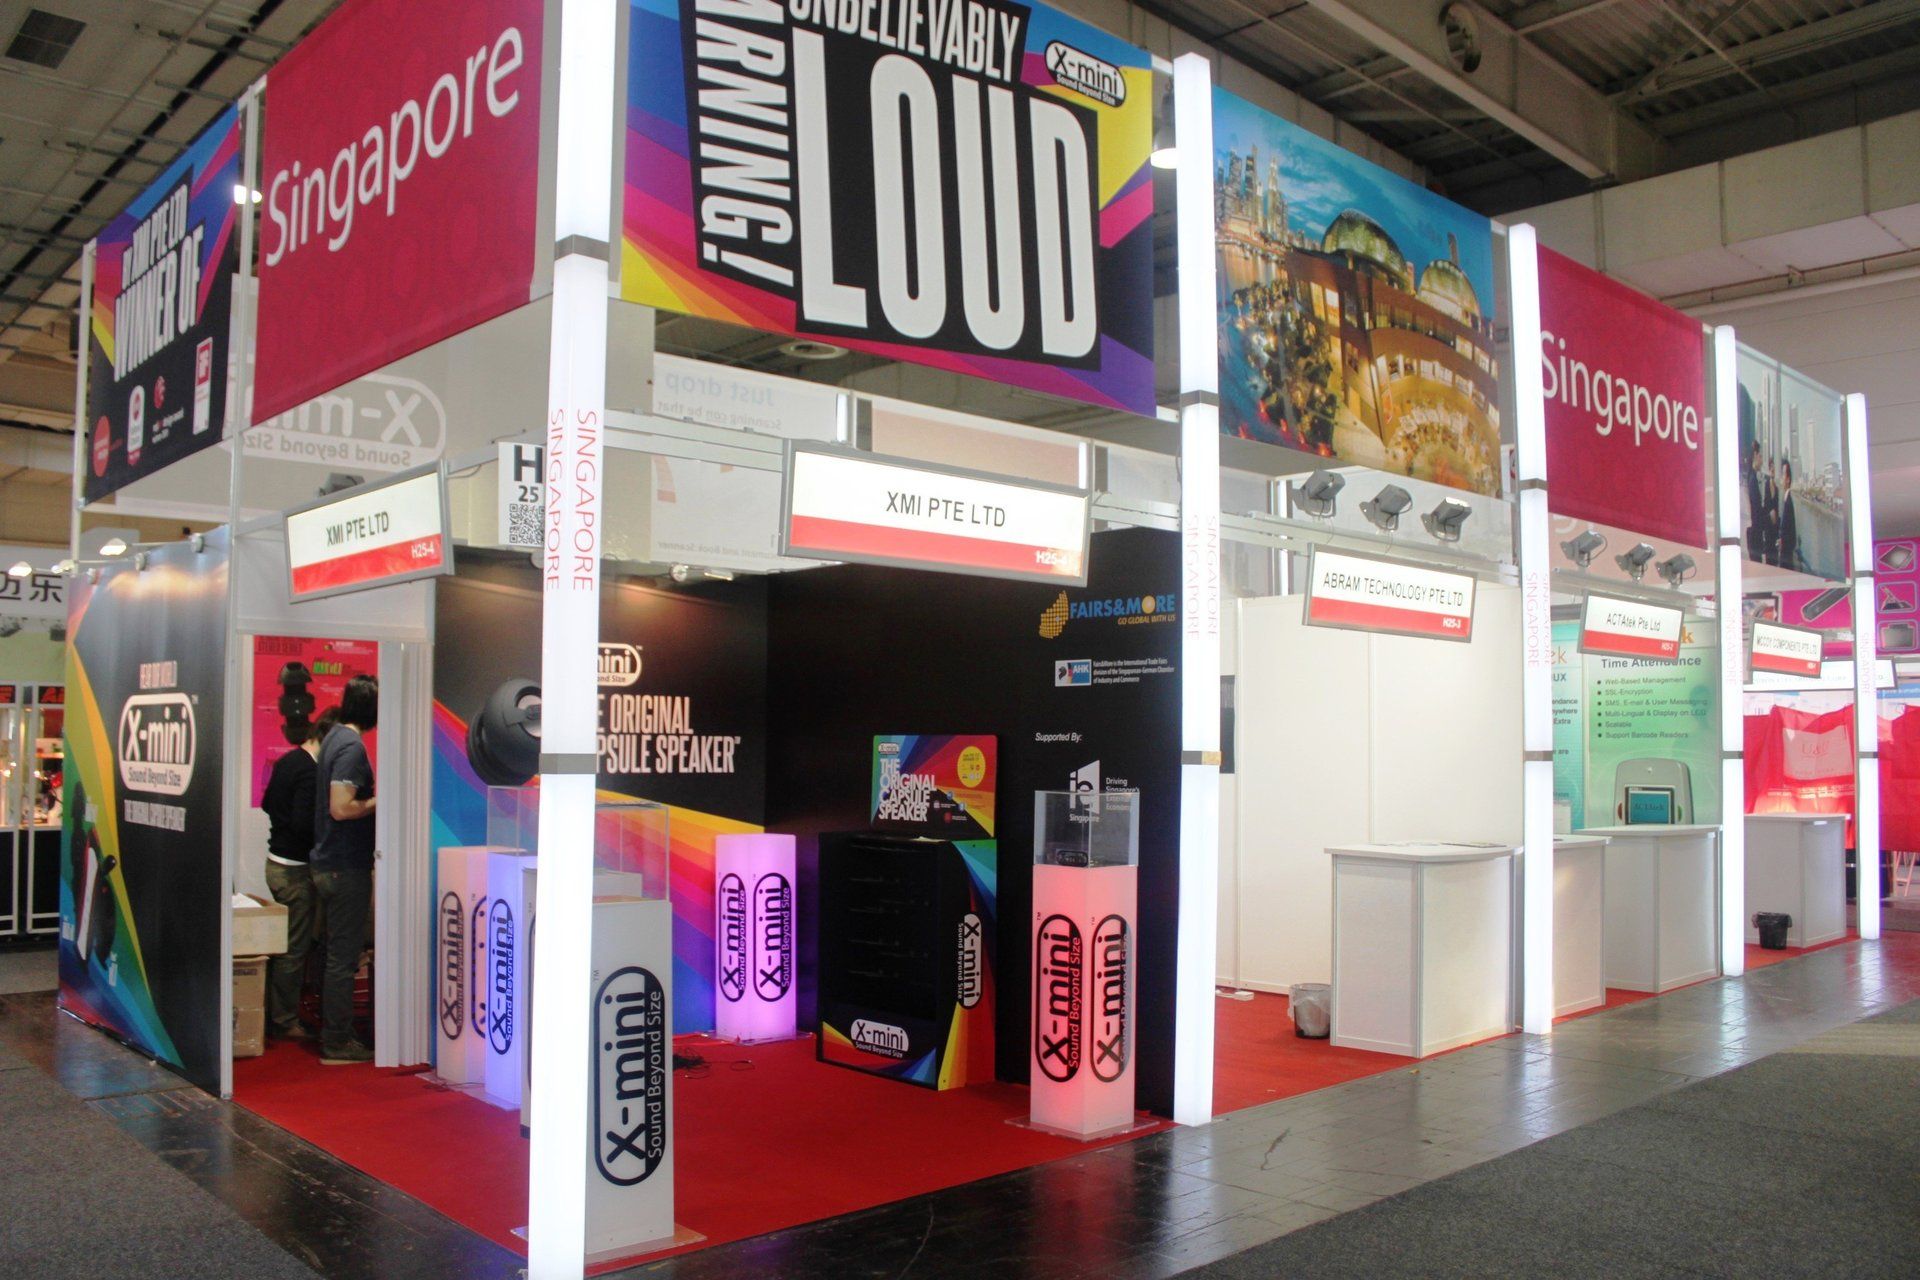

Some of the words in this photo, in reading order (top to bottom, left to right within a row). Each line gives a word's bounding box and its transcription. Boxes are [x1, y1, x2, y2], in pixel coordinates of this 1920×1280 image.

[789, 0, 1020, 83] BELIEVABLY
[1054, 46, 1117, 95] X-mini
[266, 27, 523, 266] Singapore
[695, 0, 794, 287] RNING!
[792, 27, 1098, 357] LOUD
[114, 250, 178, 382] WINNER
[178, 224, 204, 334] OF
[1541, 330, 1699, 450] Singapore
[514, 445, 543, 484] H
[518, 485, 540, 503] 25
[546, 409, 565, 591] SINGAPORE
[573, 409, 598, 592] SINGAPORE
[886, 491, 921, 516] XMI
[928, 497, 965, 522] PTE
[971, 504, 1006, 527] LTD
[326, 524, 343, 547] XMI
[346, 517, 366, 542] PTE
[368, 511, 390, 536] LTD
[411, 542, 435, 559] H25-4
[1070, 595, 1176, 619] FAIRS&MORE
[1323, 572, 1361, 592] ABRAM
[1364, 577, 1427, 601] TECHNOLOGY
[1429, 587, 1445, 604] PTE
[1447, 591, 1464, 607] LTD
[1606, 613, 1636, 629] ACTAtek
[1637, 617, 1649, 630] Pte
[1073, 664, 1089, 674] AHK
[1602, 658, 1628, 669] Time
[1642, 676, 1686, 685] Management
[610, 694, 694, 734] ORIGINAL
[125, 706, 188, 764] X-mini
[1035, 732, 1070, 743] Supported
[880, 758, 901, 774] THE
[880, 774, 937, 791] ORIGINAL
[1105, 777, 1128, 787] Driving
[879, 802, 929, 822] SPEAKER
[880, 788, 931, 807] CAPSULE
[781, 887, 790, 908] Size
[722, 887, 741, 989] X-mini
[759, 887, 783, 988] X-mini
[781, 911, 791, 951] Beyond
[1070, 937, 1081, 964] Size
[443, 907, 459, 1025] X-mini
[492, 916, 508, 1039] X-mini
[781, 953, 790, 988] Sound
[963, 922, 980, 998] X-mini
[646, 991, 661, 1026] Size
[1042, 932, 1070, 1066] X-mini
[1069, 969, 1081, 1020] Beyond
[1097, 934, 1122, 1065] X-mini
[856, 1021, 904, 1050] X-mini
[1068, 1024, 1080, 1069] Sound
[605, 992, 647, 1164] X-mini
[647, 1030, 664, 1098] Beyond
[647, 1102, 662, 1158] Sound
